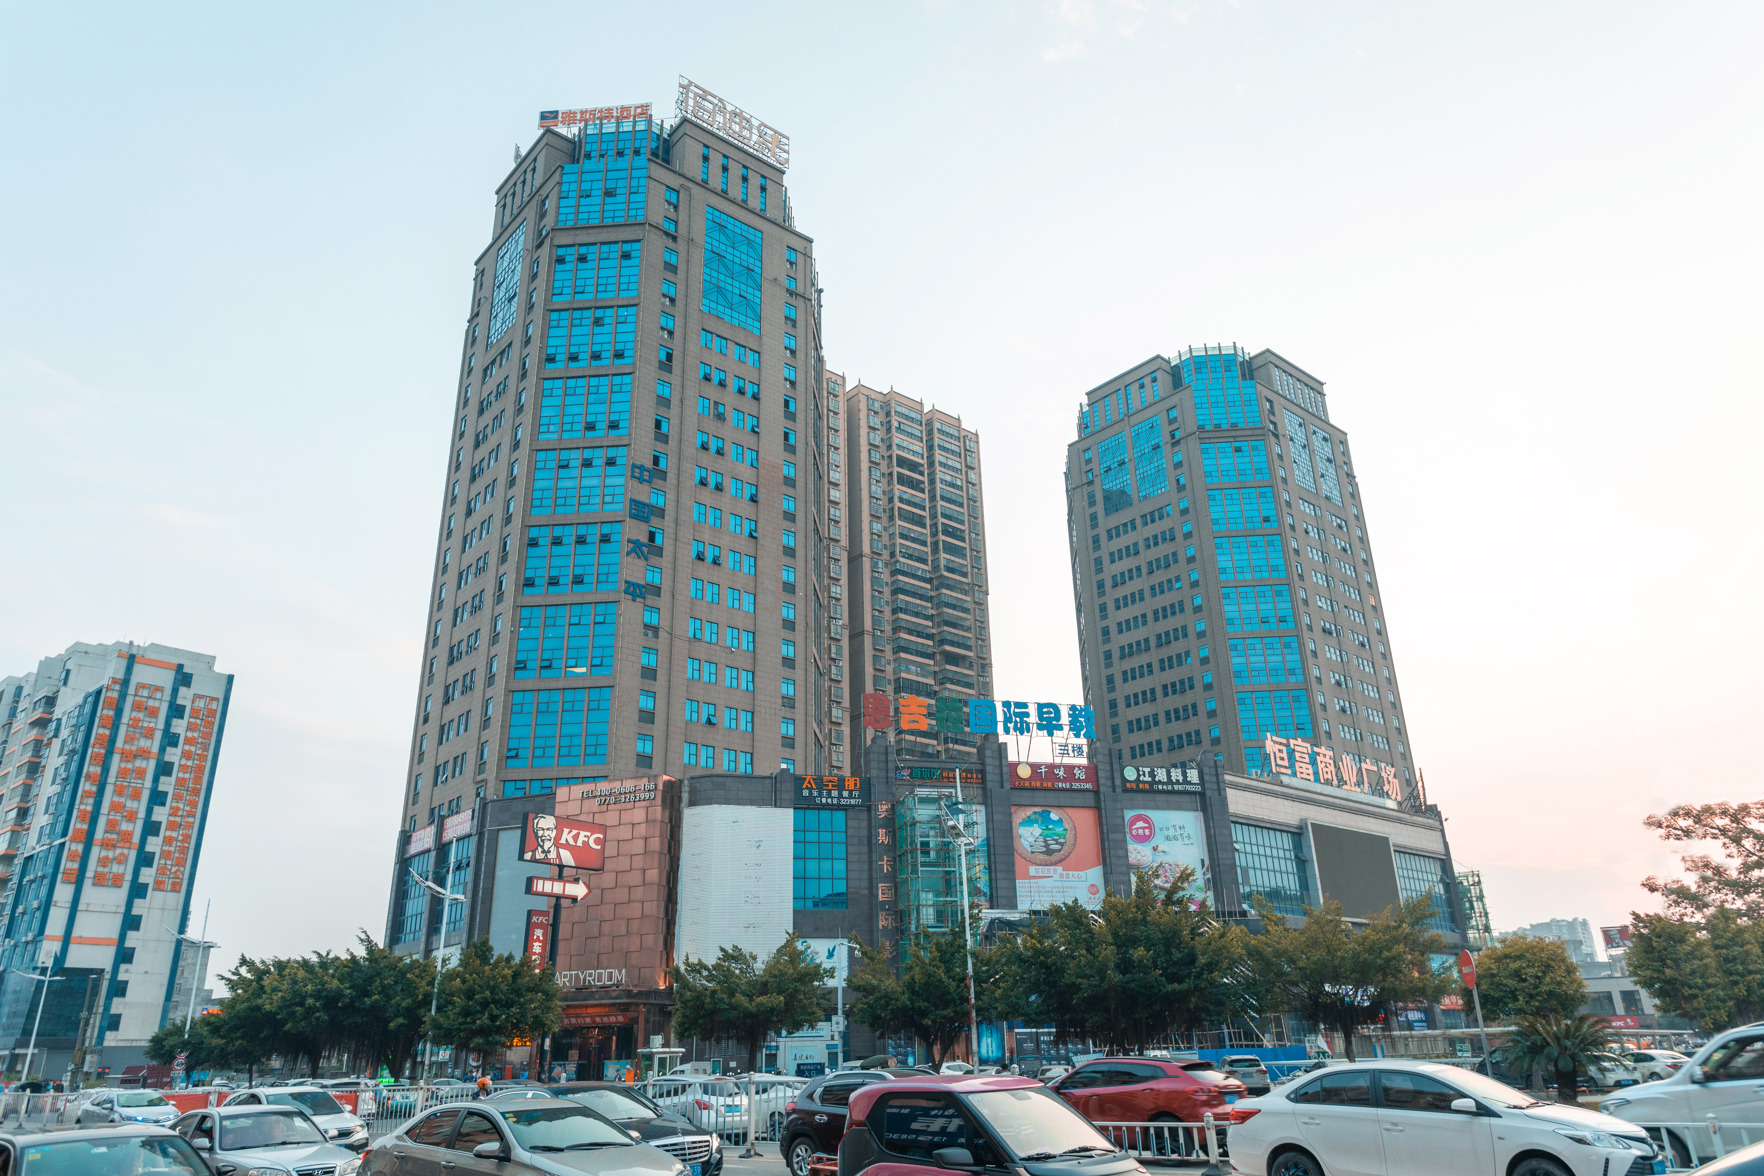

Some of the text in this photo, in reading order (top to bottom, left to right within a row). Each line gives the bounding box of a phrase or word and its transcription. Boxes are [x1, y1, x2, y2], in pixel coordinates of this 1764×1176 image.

[560, 104, 651, 126] 雅斯特酒店
[623, 463, 654, 602] 中国太平
[1057, 743, 1085, 757] 三楼
[1036, 765, 1086, 780] 千味馆
[1138, 767, 1200, 783] 江湖料理
[1265, 732, 1402, 801] 恒富商业广场
[62, 677, 122, 883] 广西海湾房地产有限公司
[802, 789, 860, 798] 音乐主题餐厅
[558, 827, 604, 850] KFC
[1131, 828, 1151, 836] 必胜客
[877, 801, 895, 930] 奥斯卡国际
[531, 915, 549, 924] KFC
